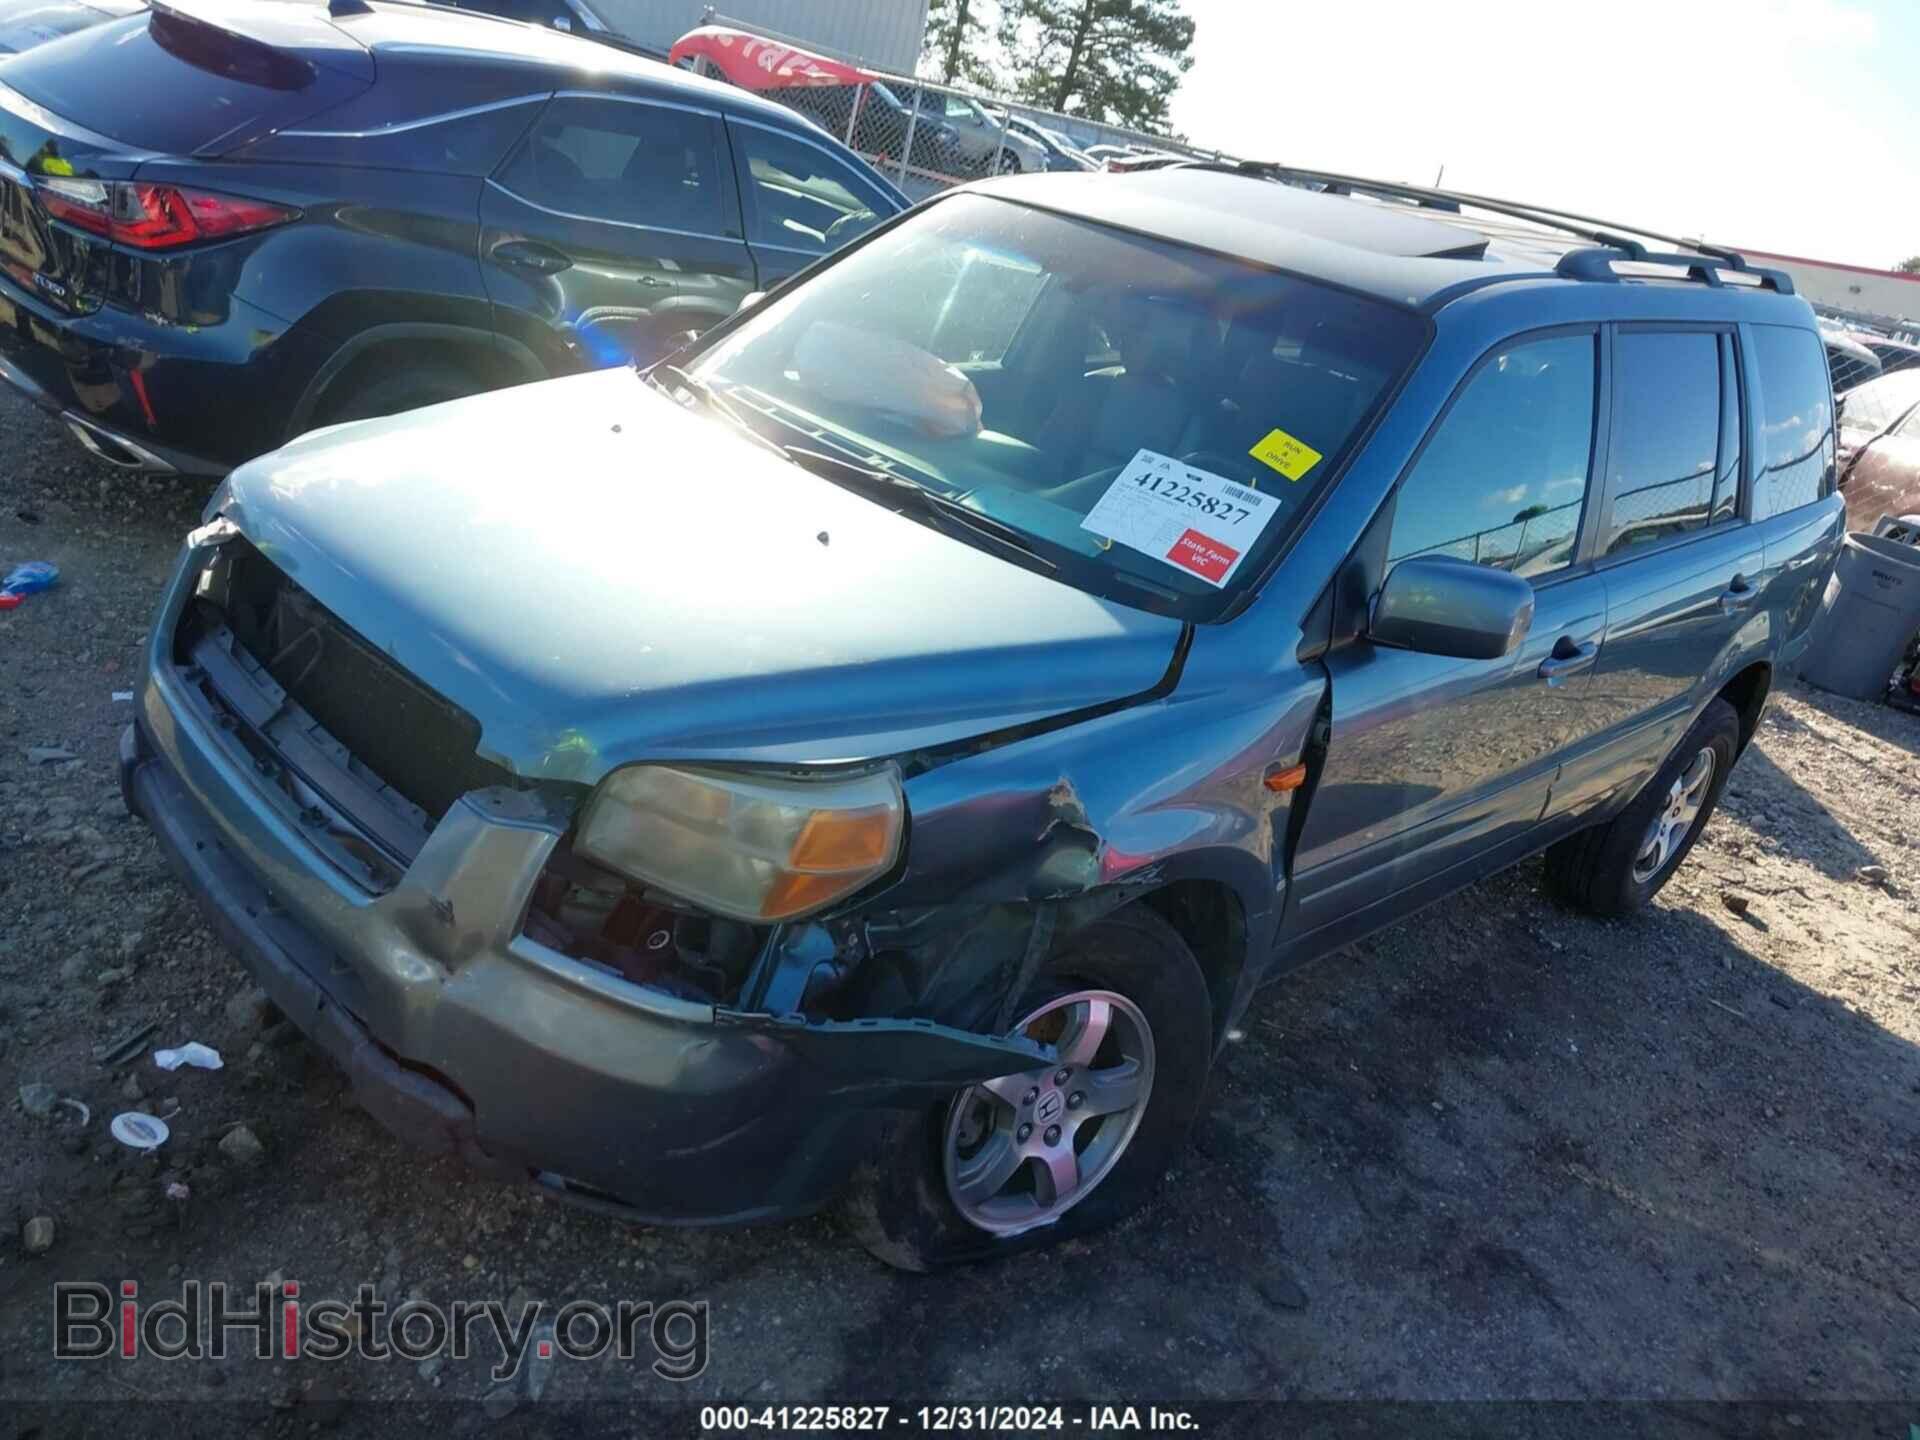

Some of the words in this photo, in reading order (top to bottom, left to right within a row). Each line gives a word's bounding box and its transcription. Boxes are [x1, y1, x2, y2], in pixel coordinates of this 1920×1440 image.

[1135, 473, 1249, 525] 41225827
[1180, 537, 1206, 554] State
[1206, 549, 1231, 566] Farm
